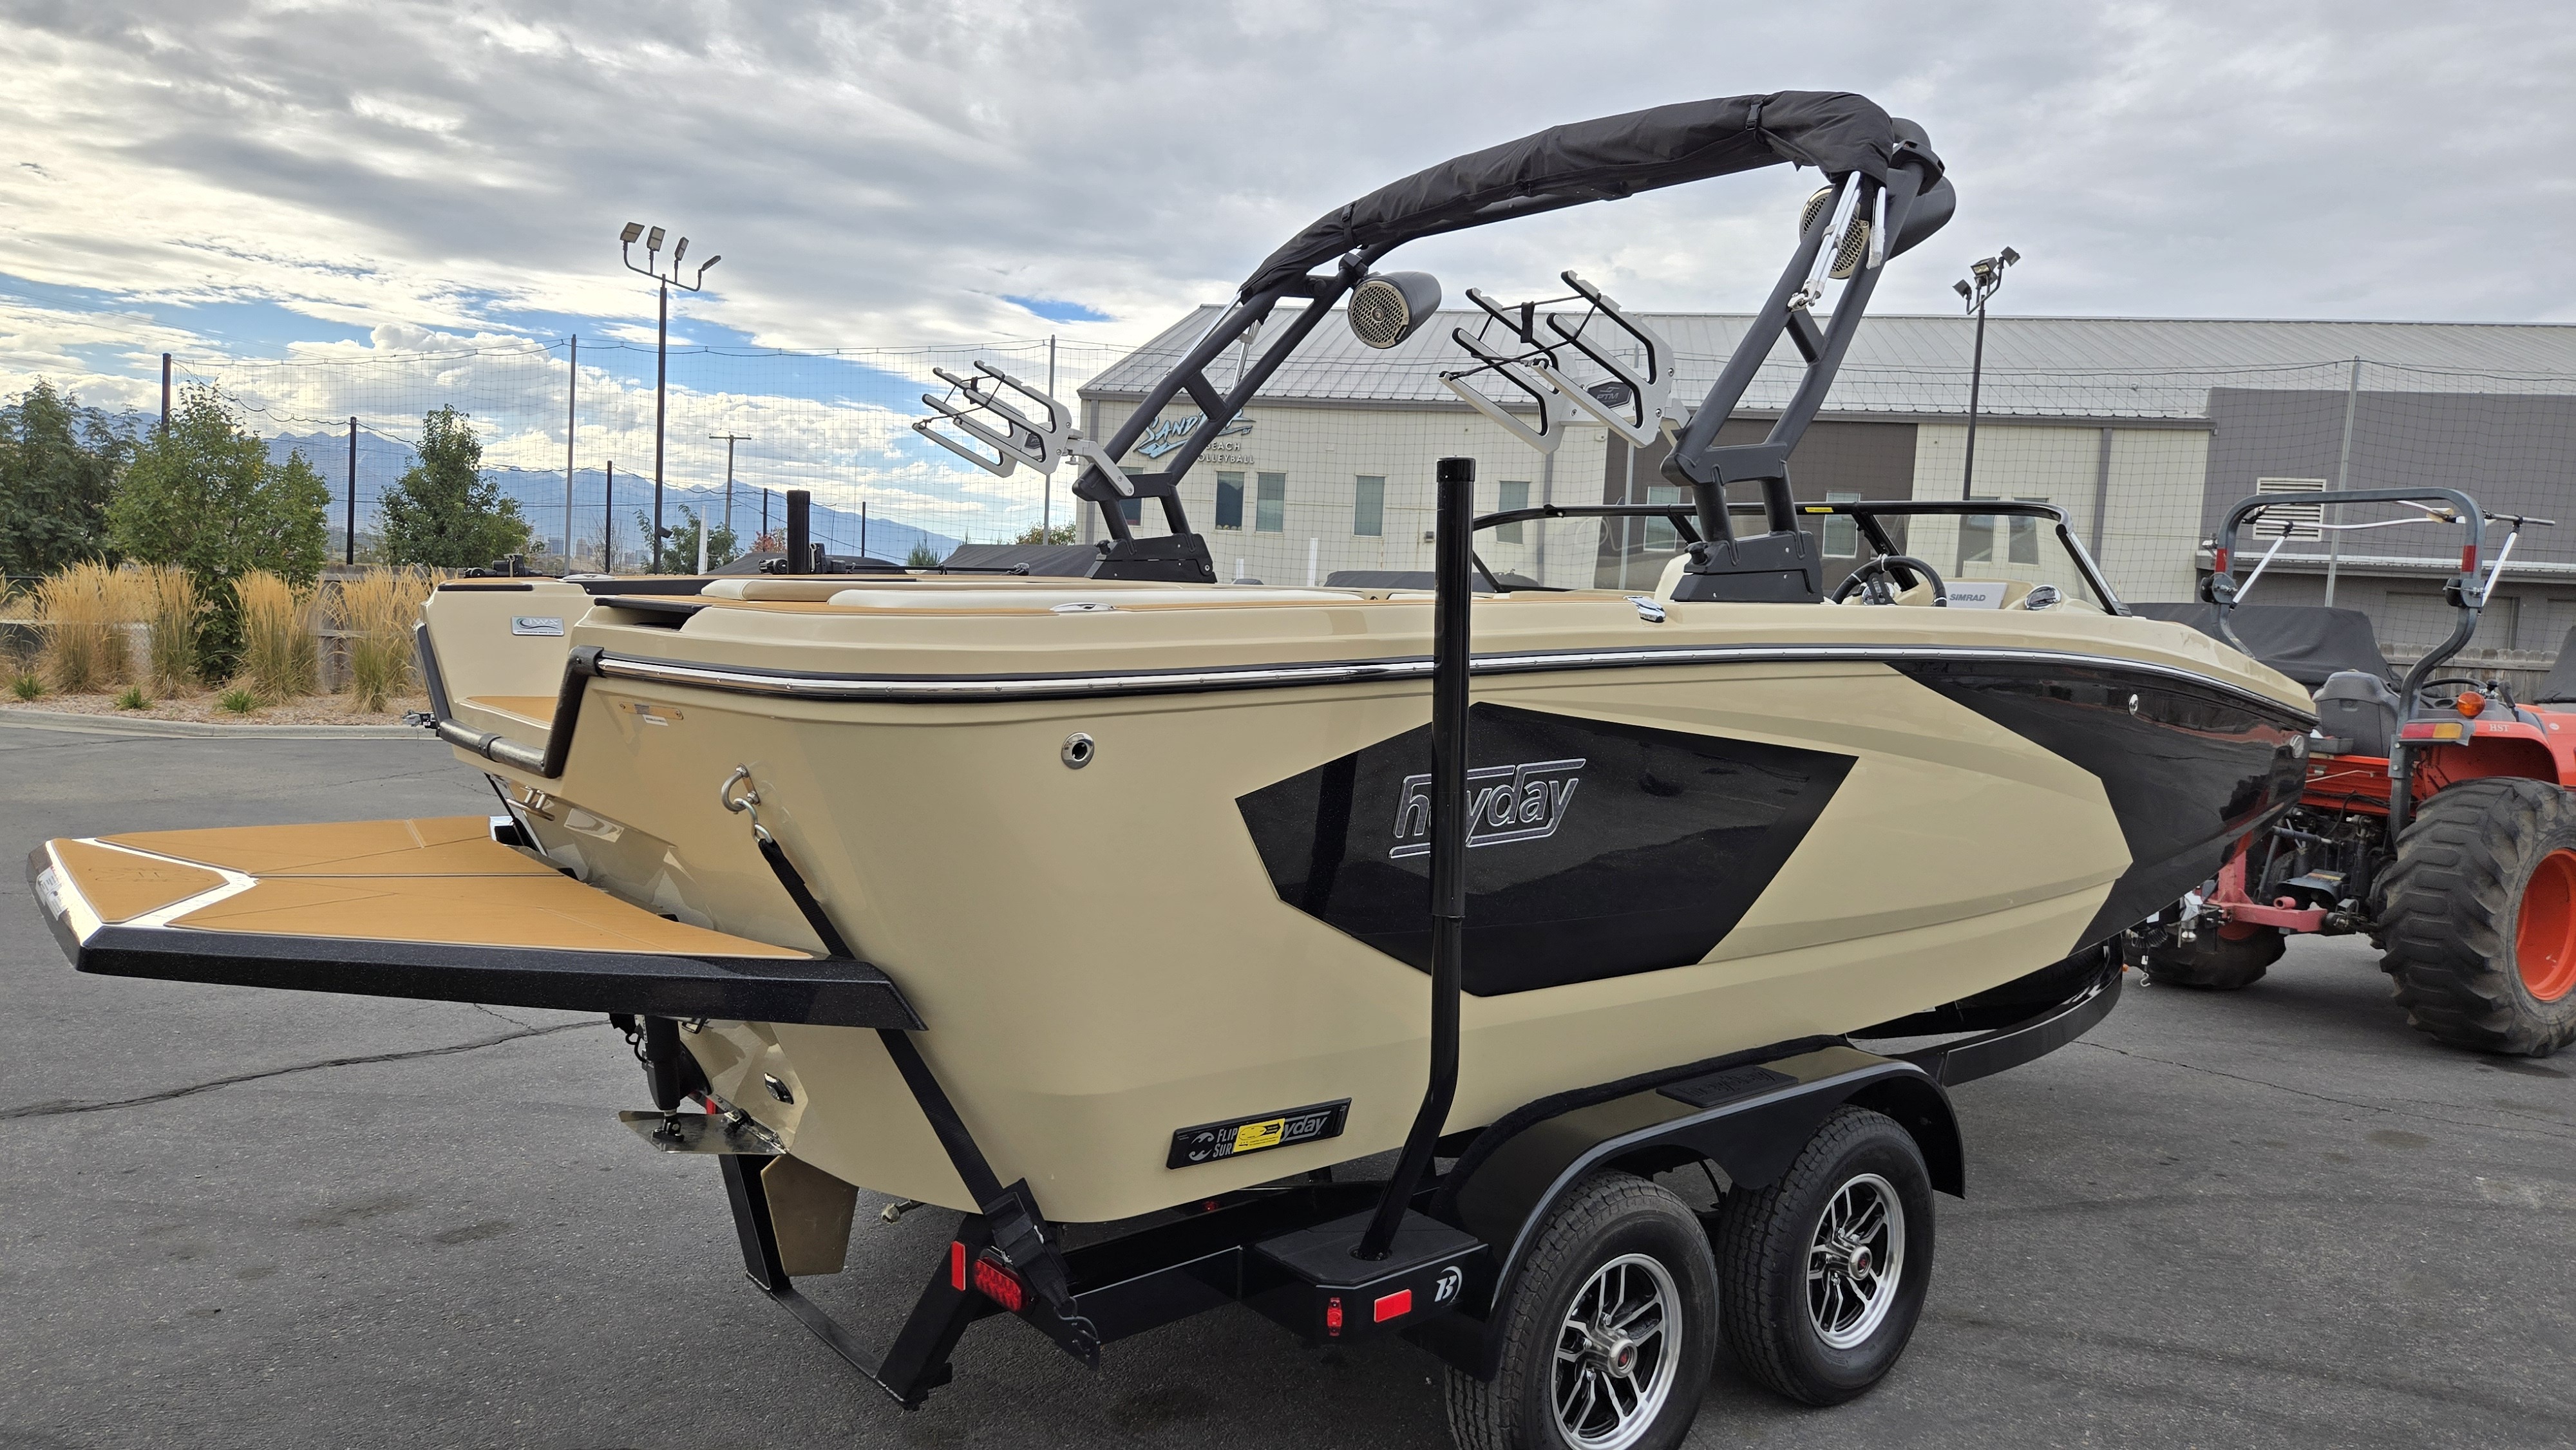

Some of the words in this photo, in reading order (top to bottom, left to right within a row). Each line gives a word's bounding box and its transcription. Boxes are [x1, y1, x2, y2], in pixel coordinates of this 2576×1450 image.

[1197, 453, 1255, 464] OLLEYBALL
[2489, 723, 2510, 732] HST
[1388, 758, 1586, 858] hyday
[1280, 1111, 1331, 1142] yday
[1216, 1127, 1238, 1143] FLIP
[1212, 1142, 1234, 1158] SUR
